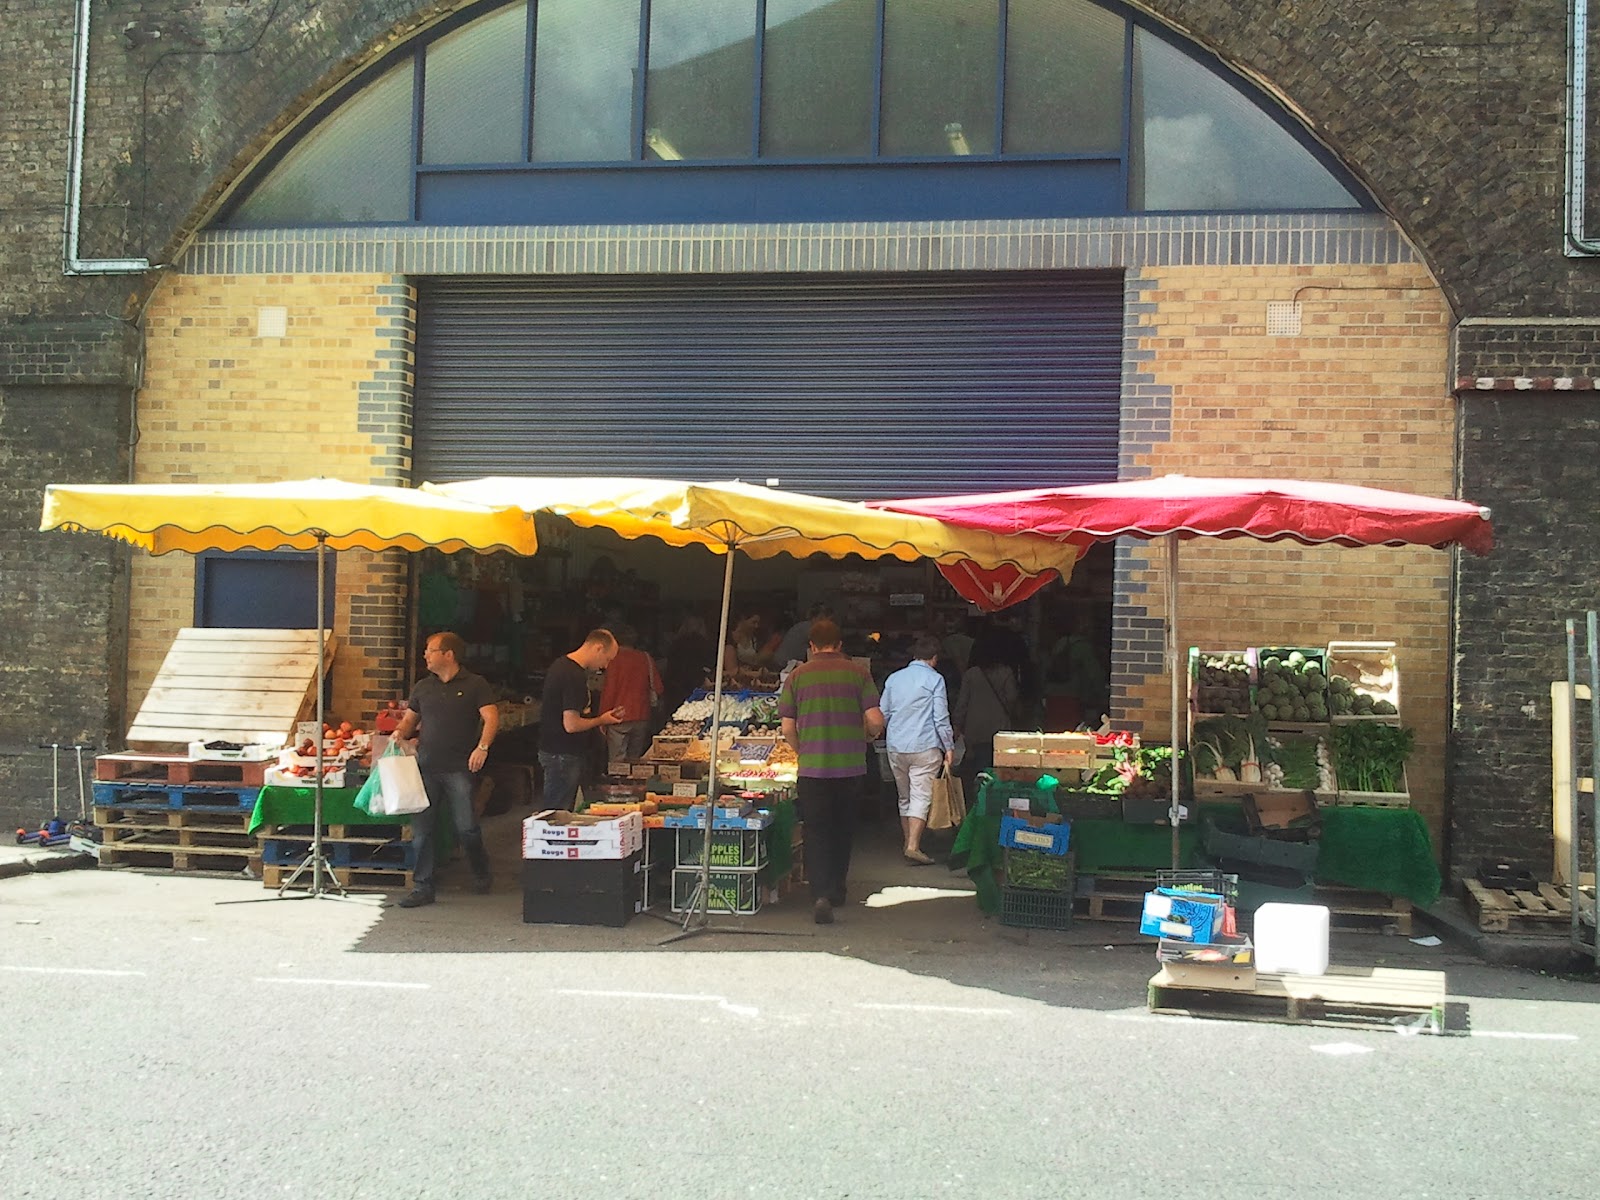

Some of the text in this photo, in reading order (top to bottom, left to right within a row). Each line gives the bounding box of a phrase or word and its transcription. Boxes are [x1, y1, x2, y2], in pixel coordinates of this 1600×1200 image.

[542, 828, 565, 836] Rouge
[541, 849, 564, 857] Rouge
[708, 845, 740, 855] PPLES
[699, 855, 740, 865] PMMES
